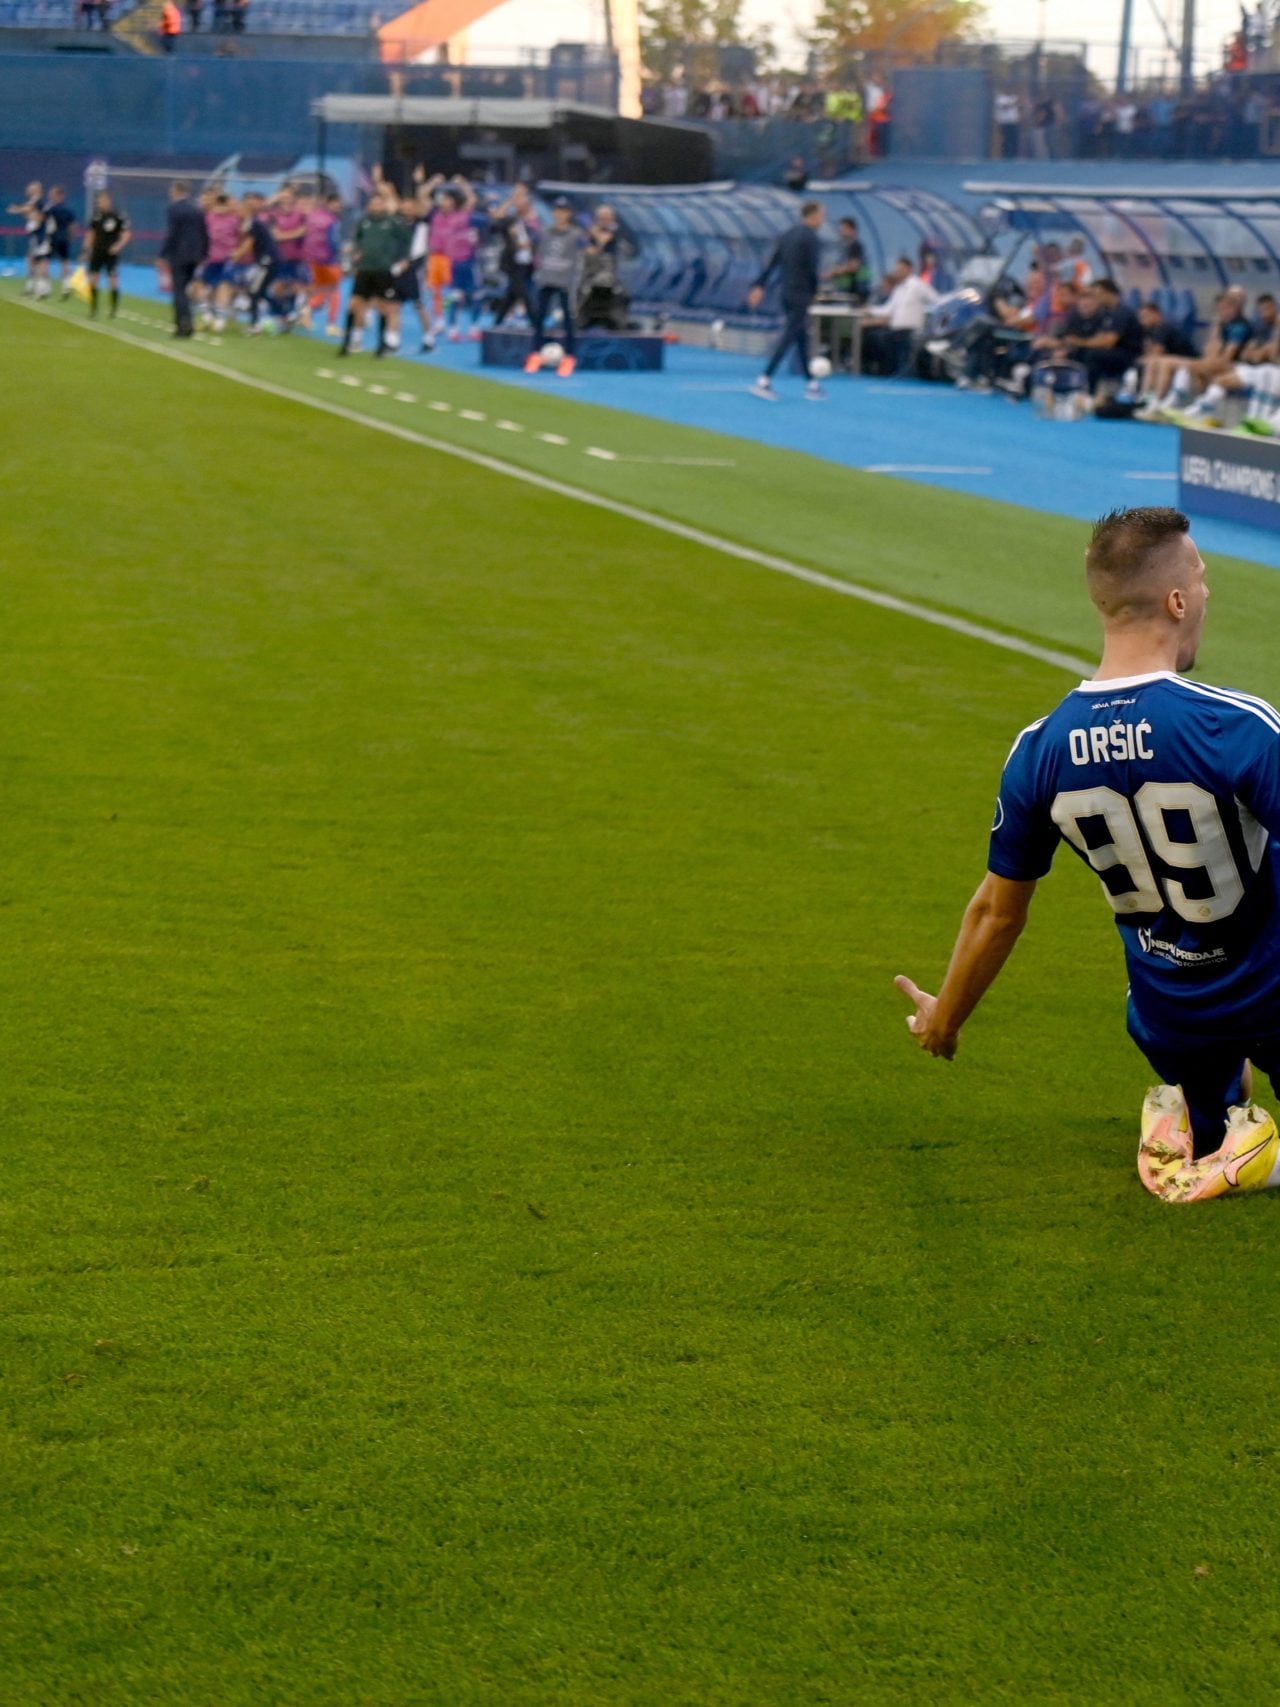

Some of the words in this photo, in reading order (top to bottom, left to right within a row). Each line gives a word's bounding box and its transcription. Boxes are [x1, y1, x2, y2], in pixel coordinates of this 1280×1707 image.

[1069, 718, 1154, 766] ORŠIĆ
[1050, 781, 1245, 923] 99
[1176, 948, 1225, 961] PREDAJE
